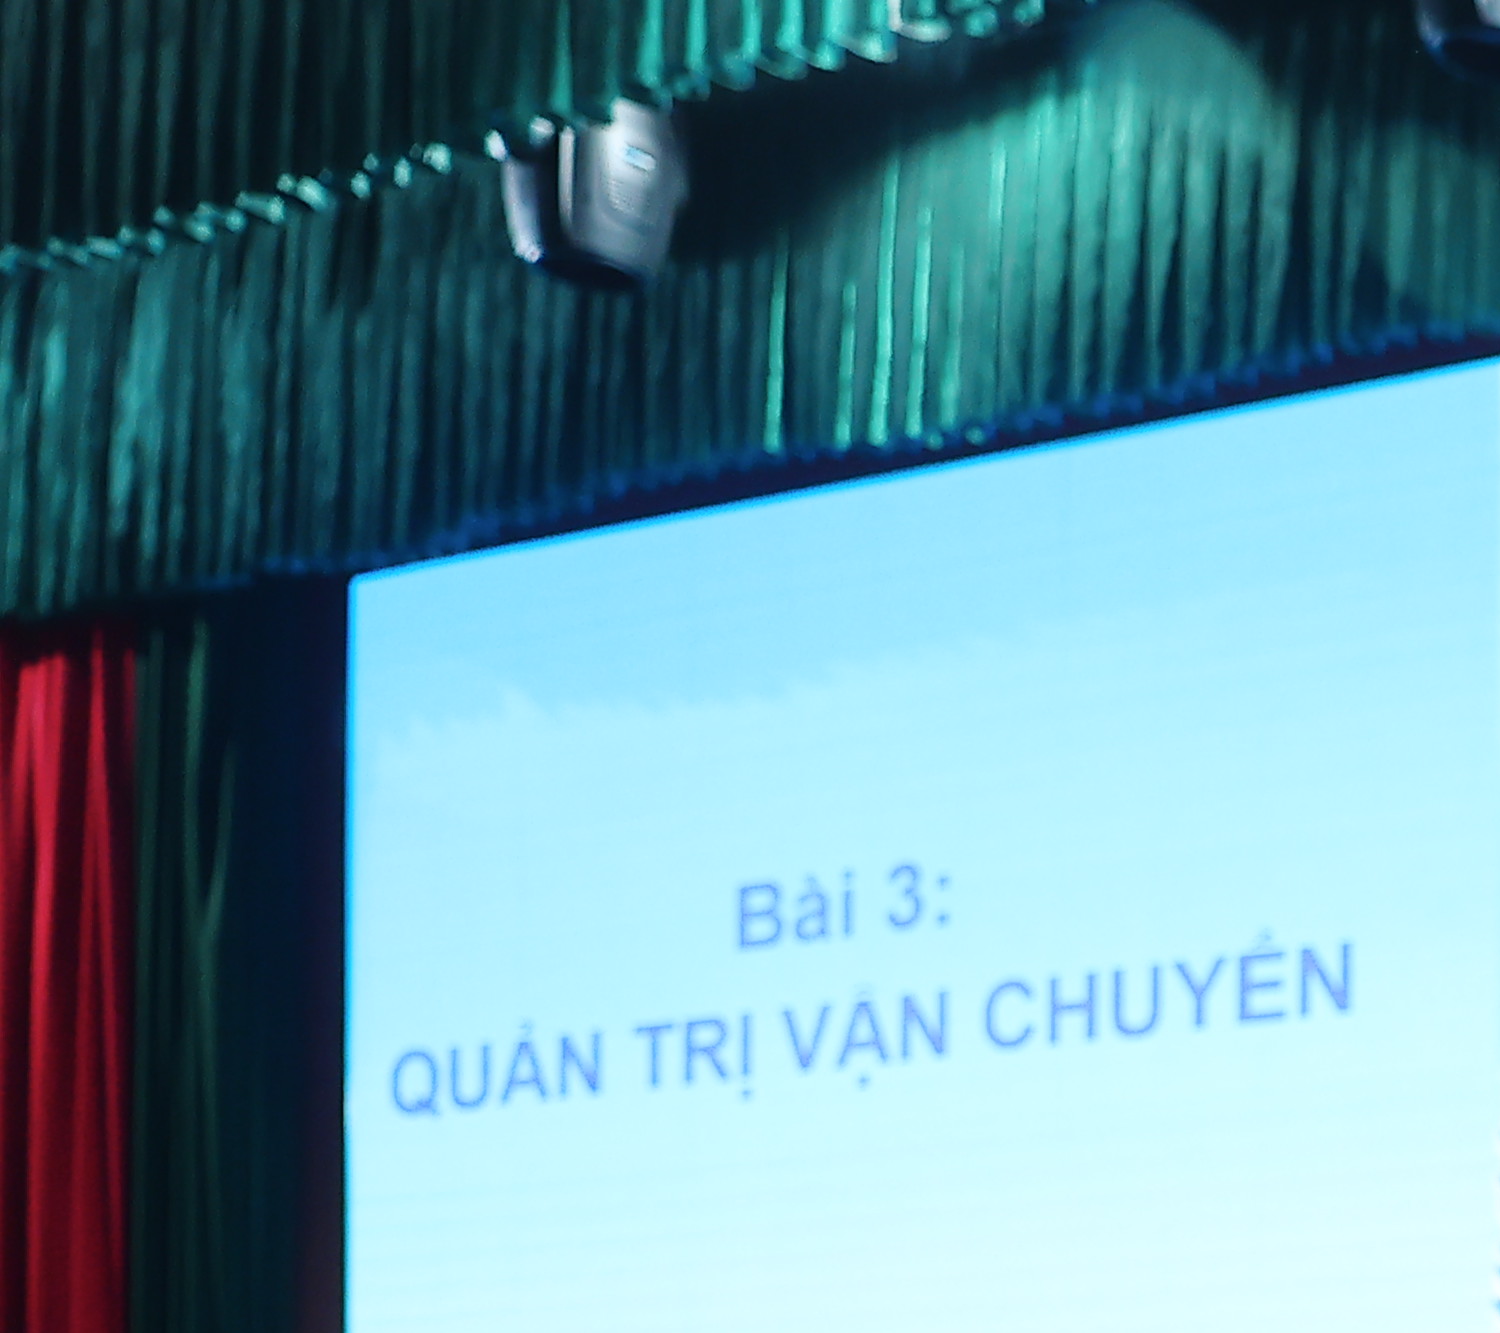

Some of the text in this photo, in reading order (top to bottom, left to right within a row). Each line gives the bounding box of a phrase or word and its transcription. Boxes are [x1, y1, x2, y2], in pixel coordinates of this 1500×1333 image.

[736, 862, 951, 951] Bài 3:
[389, 930, 1355, 1118] QUẢN TRỊ VẬN CHUYỂN
